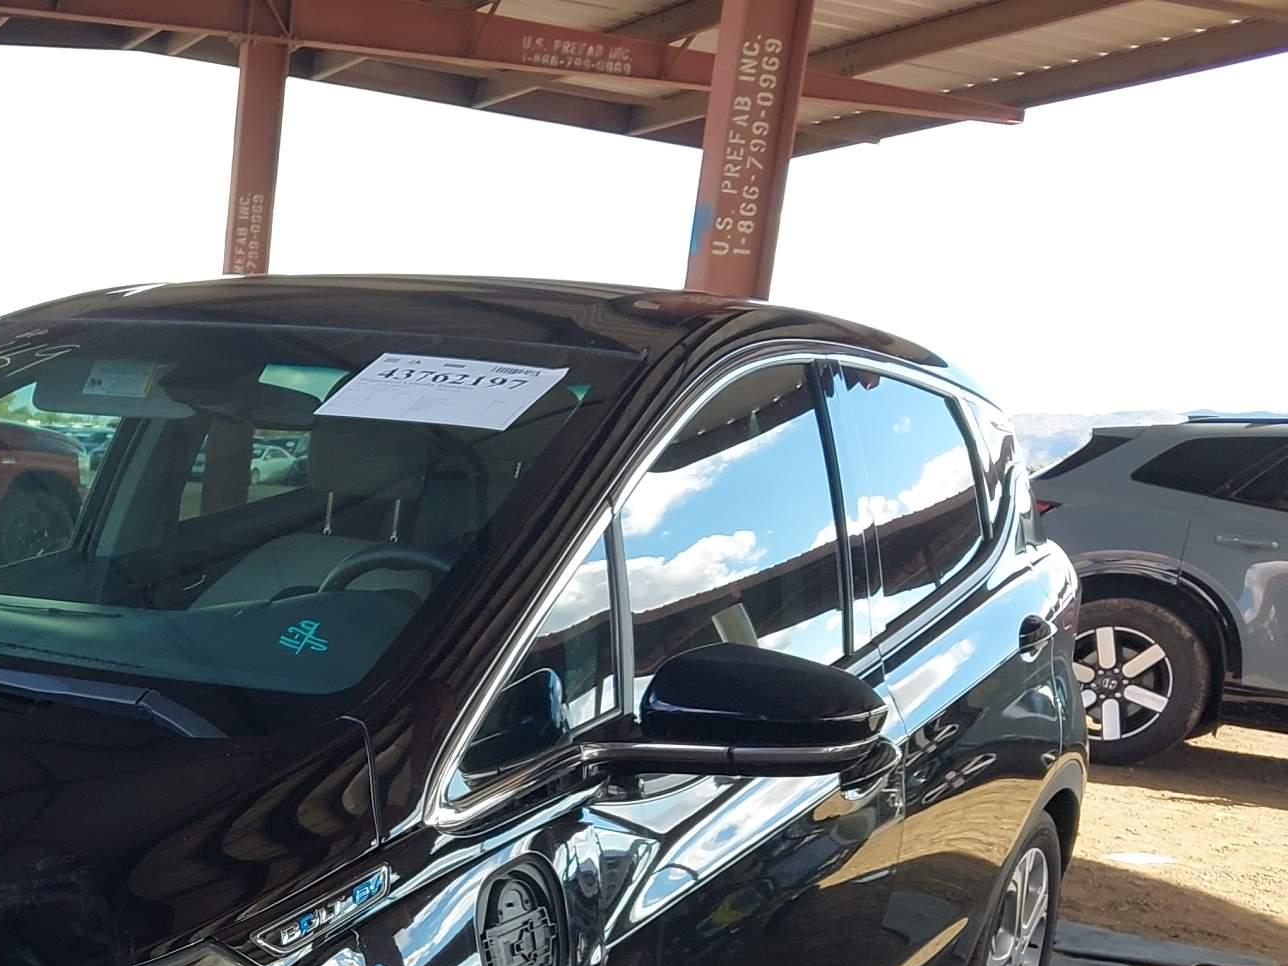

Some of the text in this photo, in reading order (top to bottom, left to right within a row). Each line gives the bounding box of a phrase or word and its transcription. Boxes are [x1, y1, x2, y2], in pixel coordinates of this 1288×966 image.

[553, 39, 604, 58] PREFAB
[712, 34, 762, 256] U.S. PREFAB INC.
[733, 38, 783, 255] 1-866-799-0969
[238, 193, 252, 220] INC.
[378, 366, 528, 390] 43762197
[280, 895, 346, 945] BOLT
